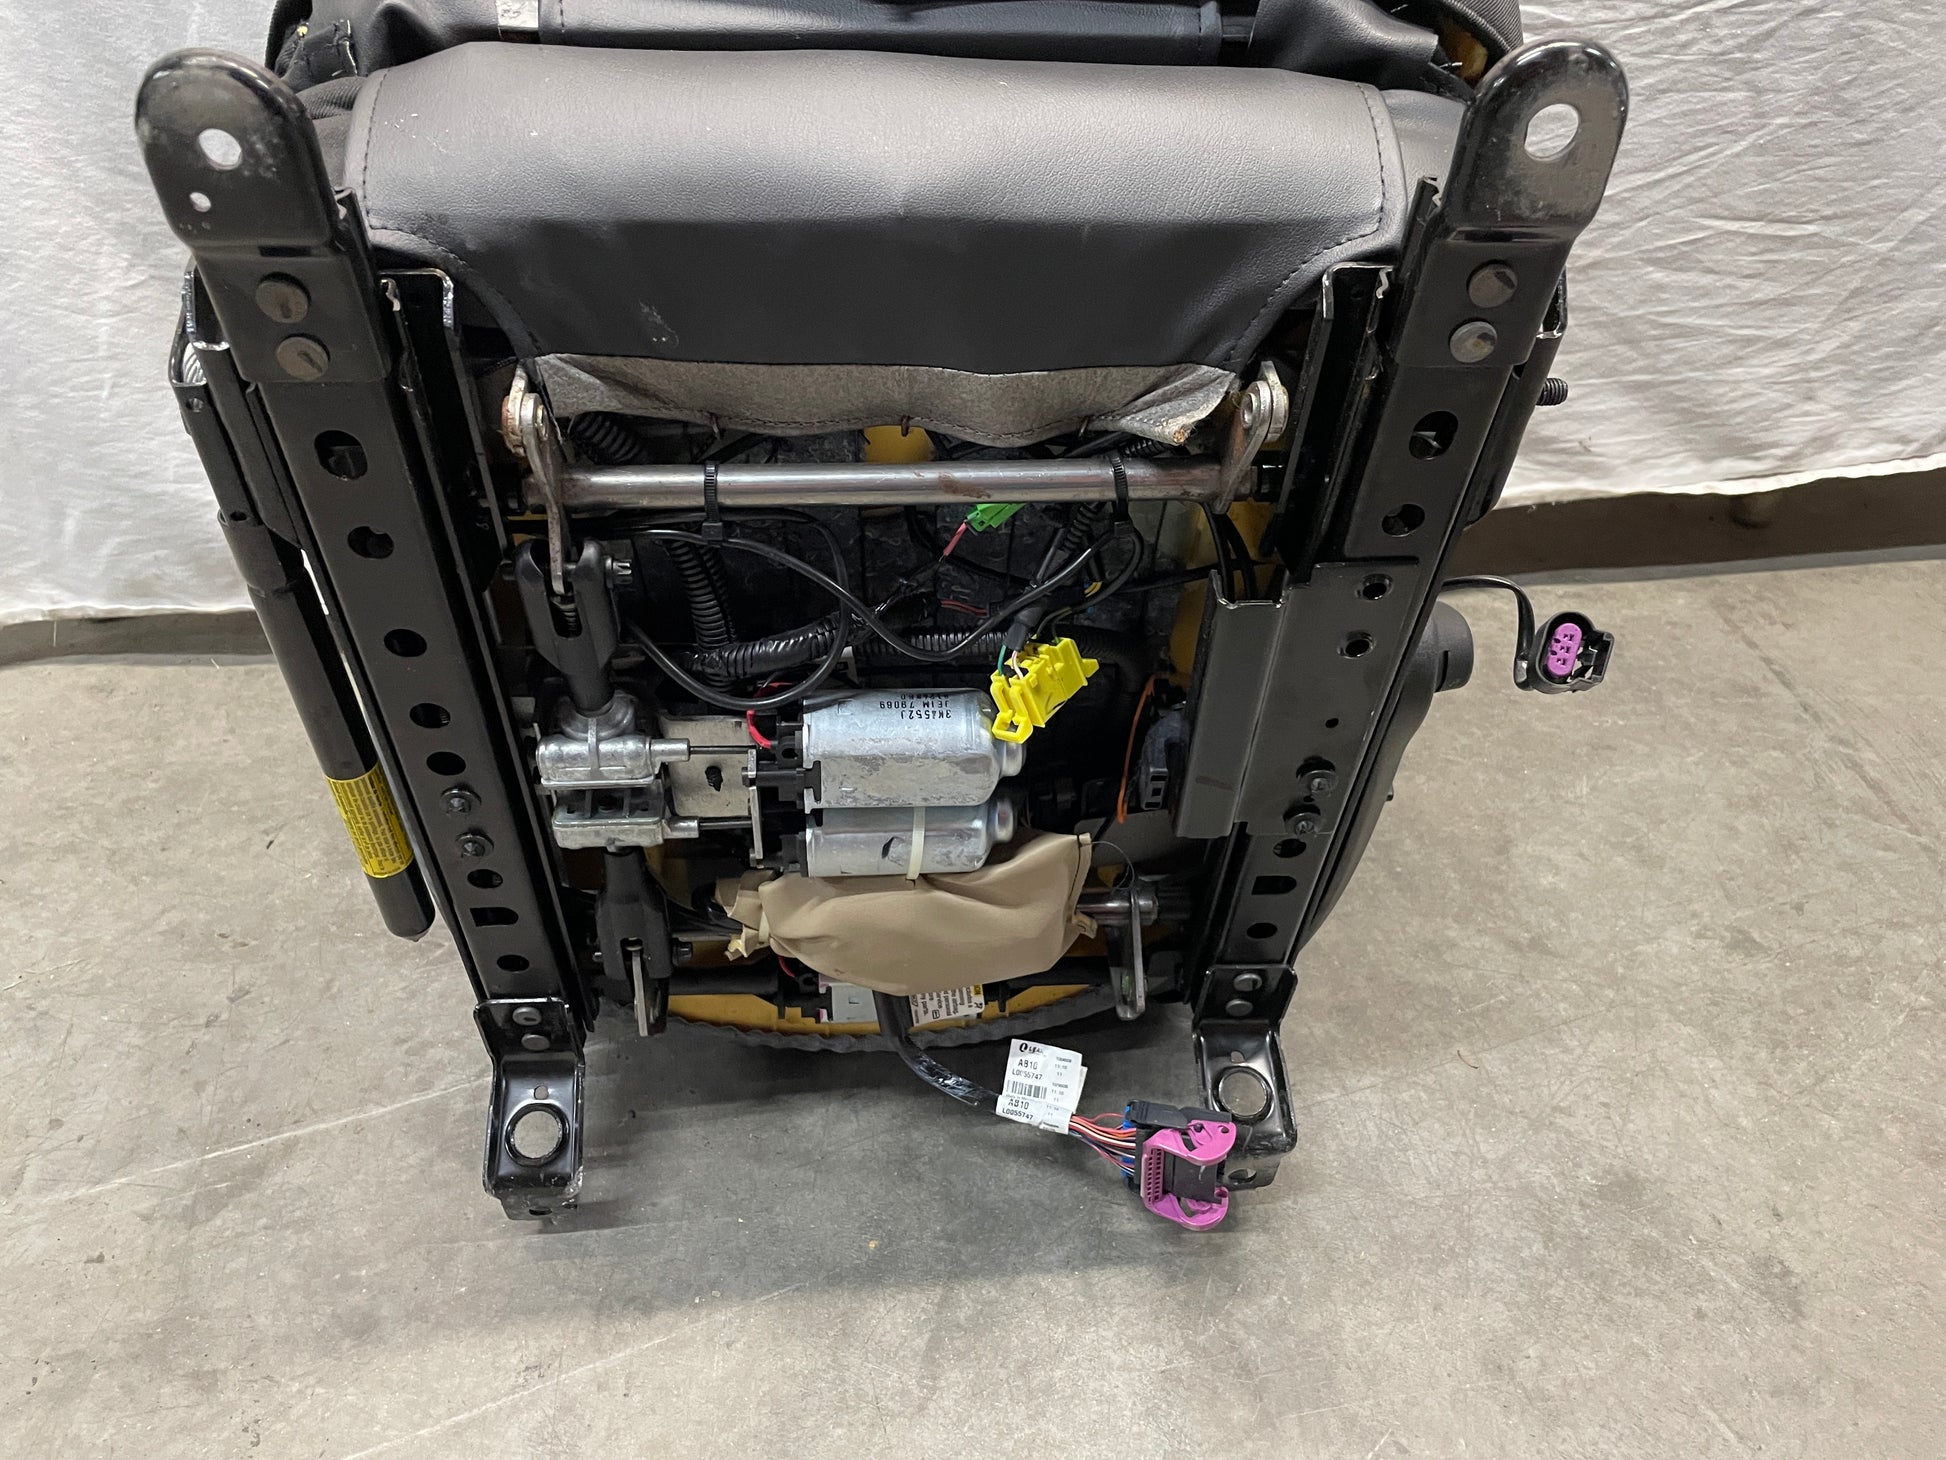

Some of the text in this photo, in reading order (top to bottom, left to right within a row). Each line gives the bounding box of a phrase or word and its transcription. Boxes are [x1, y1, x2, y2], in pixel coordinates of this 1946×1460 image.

[901, 709, 952, 719] 3K4552J
[1018, 1058, 1038, 1070] AB10
[1008, 1098, 1030, 1110] AB10
